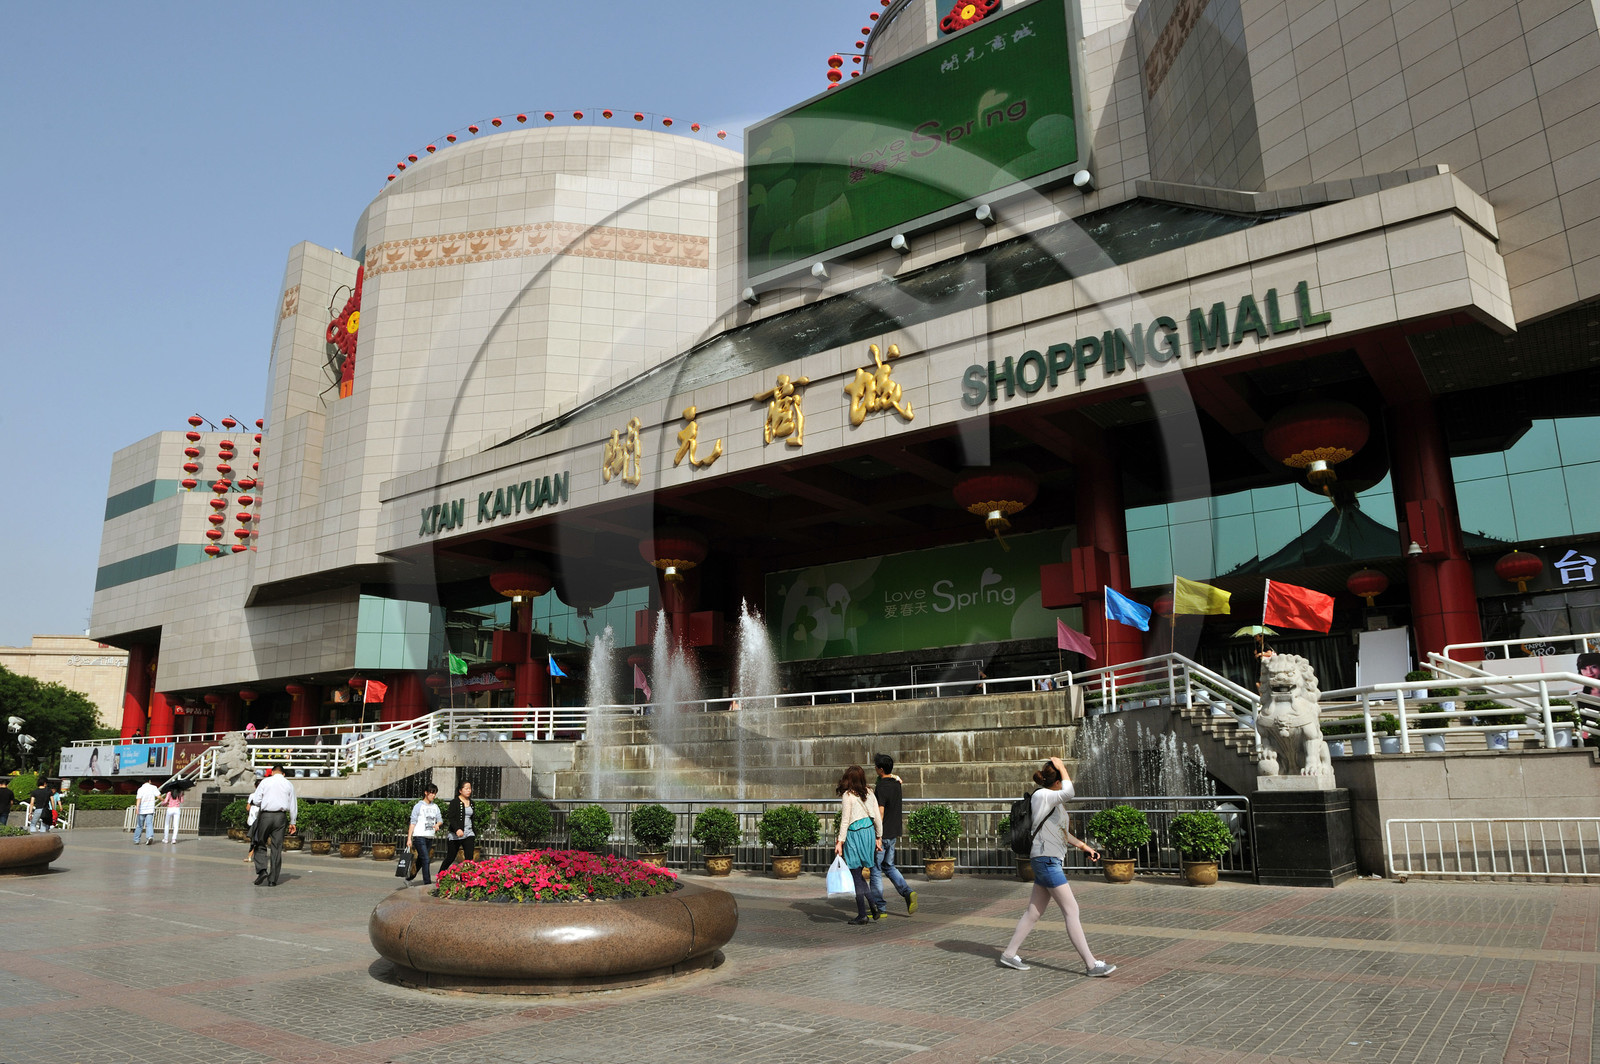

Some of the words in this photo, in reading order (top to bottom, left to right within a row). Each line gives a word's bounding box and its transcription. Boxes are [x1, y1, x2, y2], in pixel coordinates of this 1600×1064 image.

[910, 89, 1028, 158] Spring
[849, 138, 905, 169] Love
[849, 151, 908, 185] 爱春天
[962, 316, 1181, 407] SHOPPING
[1188, 280, 1332, 354] MALL
[477, 471, 570, 522] KAIYUAN
[1553, 549, 1597, 585] 台
[884, 588, 926, 603] Love
[932, 567, 1016, 613] Spring
[884, 601, 929, 619] 爱春天
